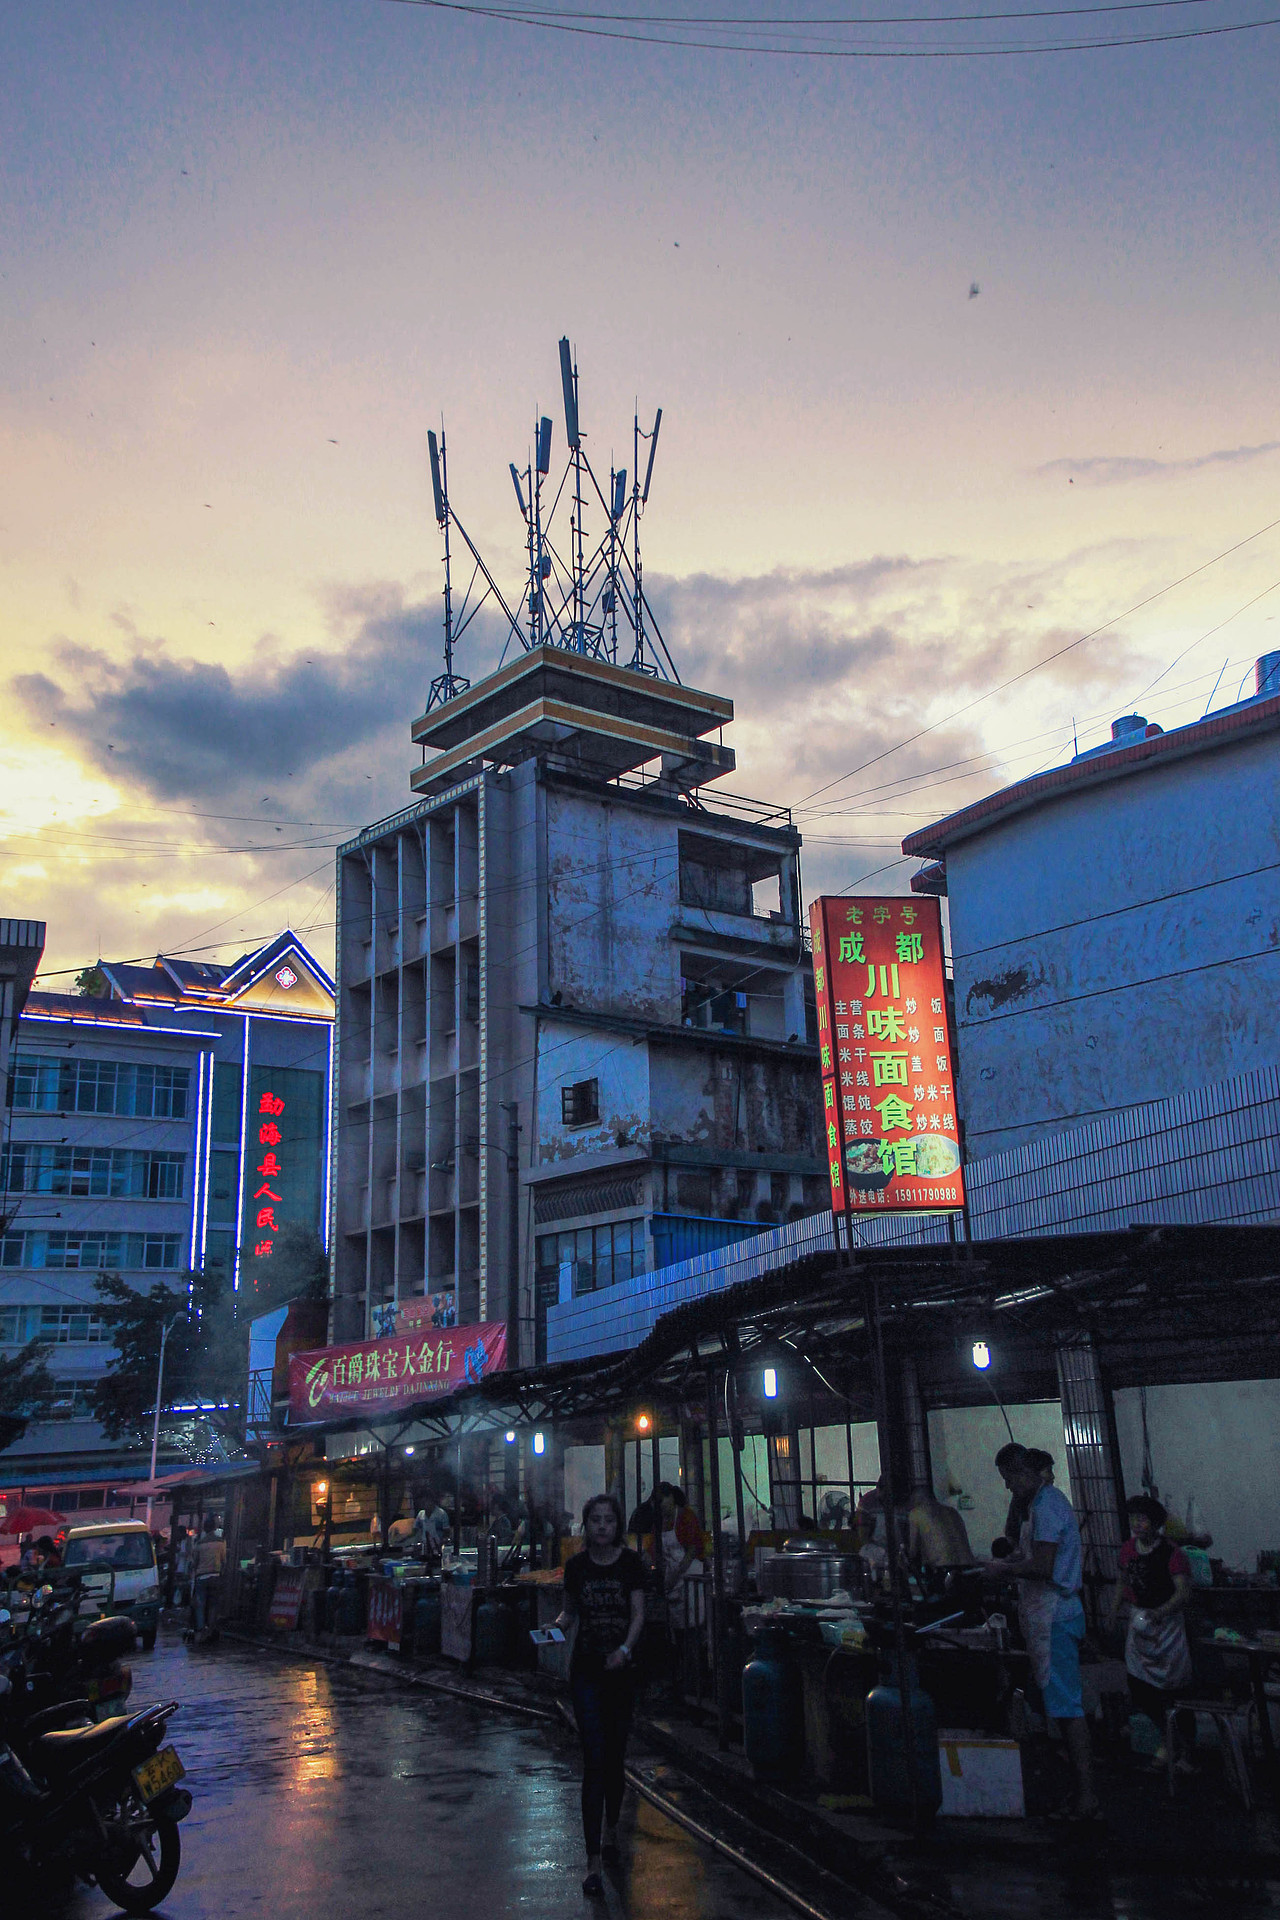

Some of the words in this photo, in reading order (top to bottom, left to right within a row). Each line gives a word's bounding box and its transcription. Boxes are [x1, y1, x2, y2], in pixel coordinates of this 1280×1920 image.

[846, 905, 918, 926] 老字号
[838, 931, 925, 965] 成都
[835, 999, 863, 1016] 主营
[905, 997, 943, 1015] 炒饭
[836, 1023, 865, 1039] 面条
[908, 1026, 945, 1043] 炒面
[813, 929, 841, 1188] 成都川味面食馆
[839, 1047, 867, 1063] 米干
[911, 1055, 948, 1073] 盖饭
[841, 1070, 870, 1087] 米线
[913, 1084, 952, 1102] 炒米干
[843, 1095, 872, 1111] 馄饨
[844, 1118, 873, 1135] 蒸饺
[916, 1113, 955, 1131] 炒米线
[895, 1187, 957, 1202] 15911790988
[331, 1340, 453, 1387] 百爵珠宝大金行
